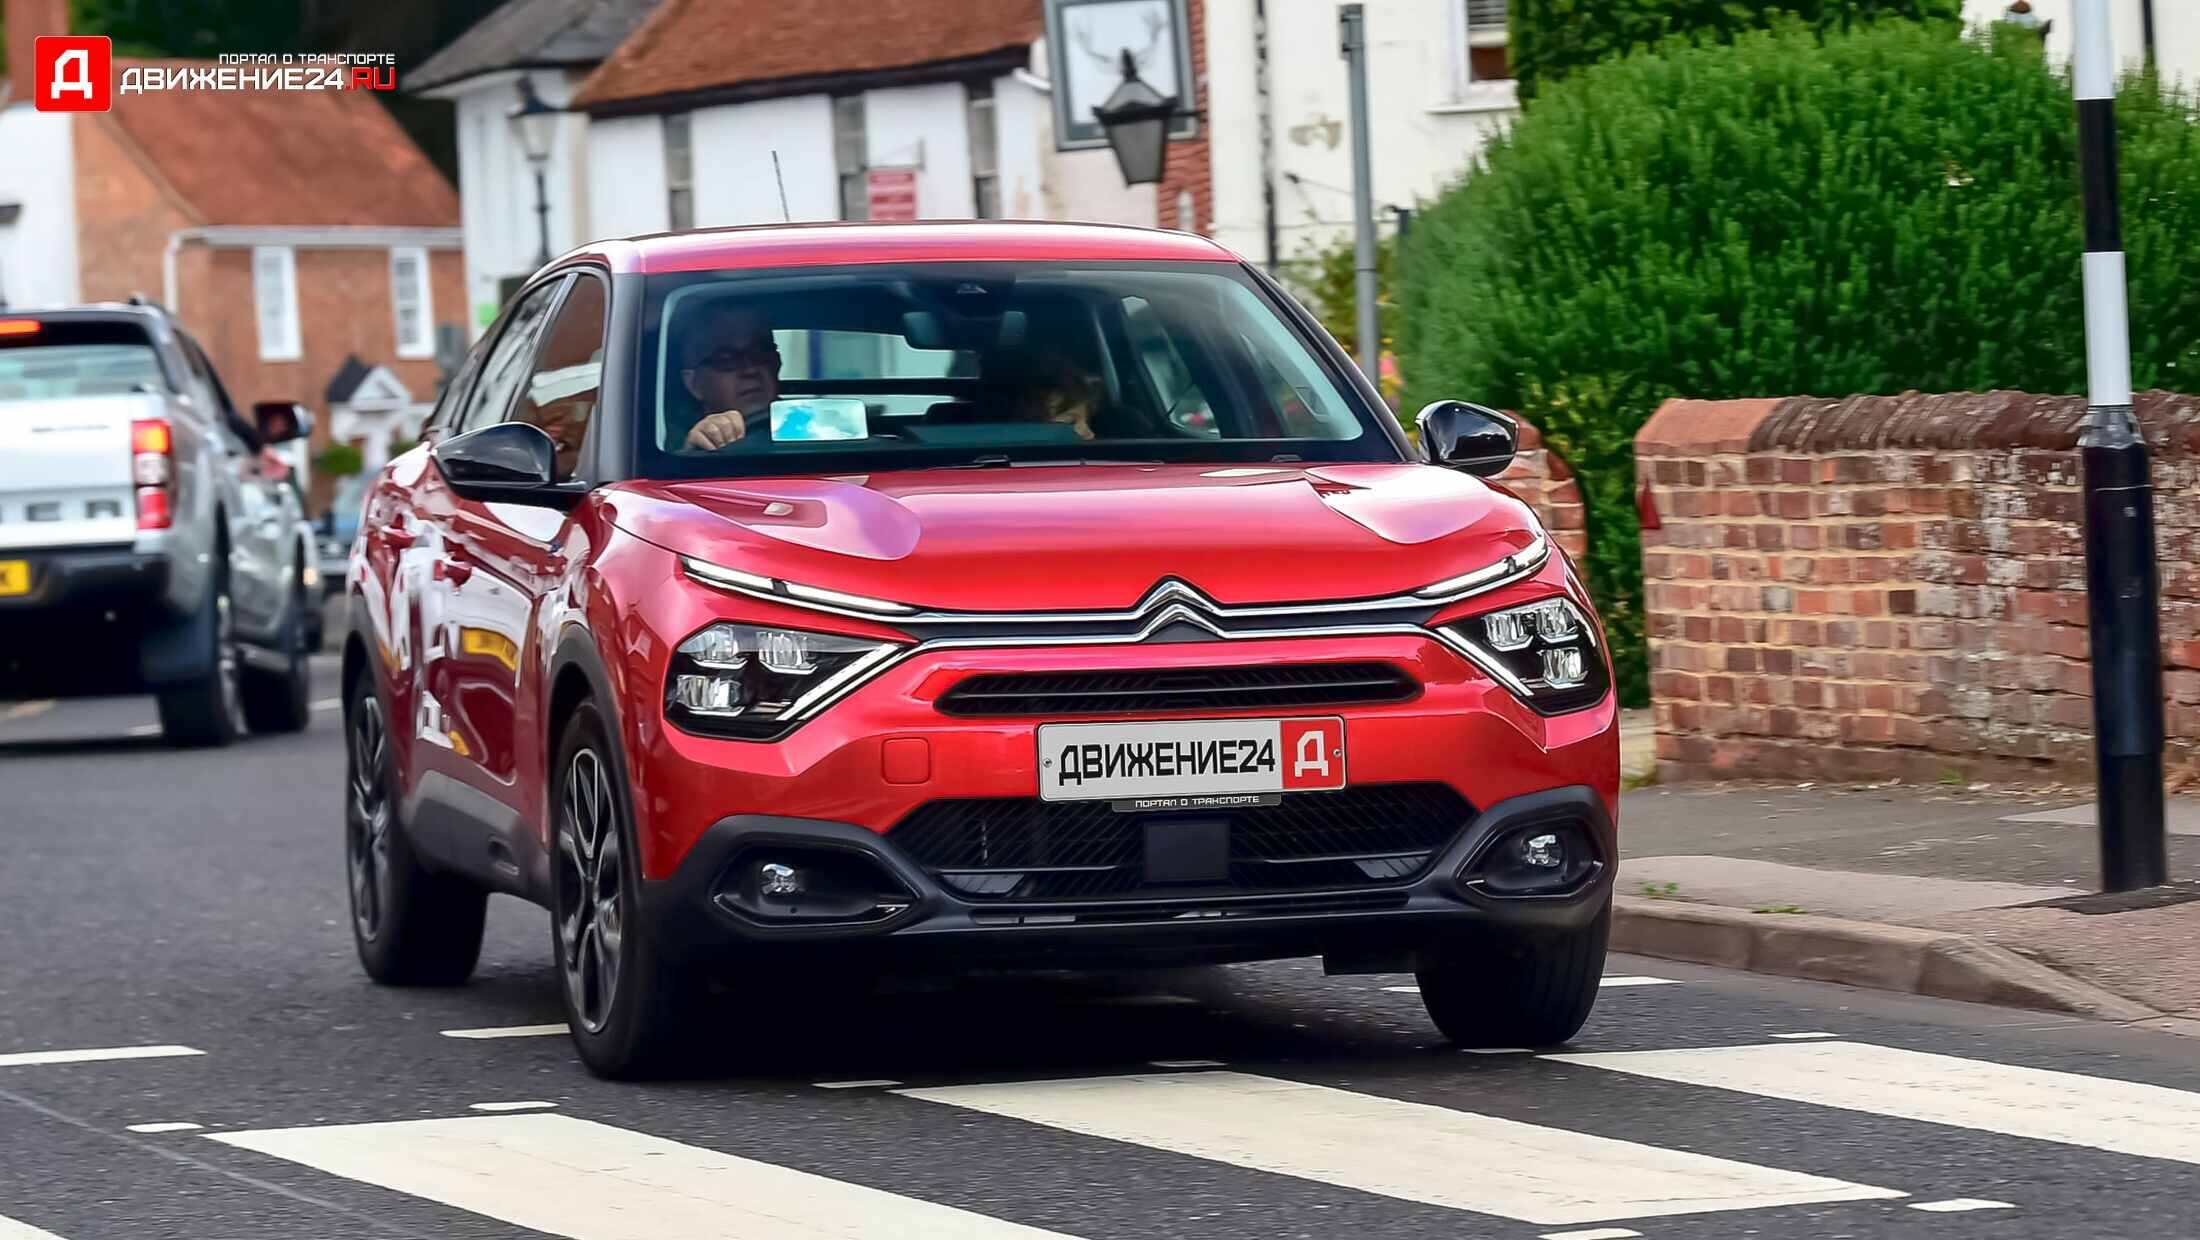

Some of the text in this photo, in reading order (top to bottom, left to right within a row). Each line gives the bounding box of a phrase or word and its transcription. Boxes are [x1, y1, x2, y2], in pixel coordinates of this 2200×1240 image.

[1058, 730, 1329, 787] ДВИЖЕНИЕ24 Д
[1135, 799, 1178, 808] ПОРТАЛ
[1191, 796, 1260, 807] ТРАНСПОРТЕ
